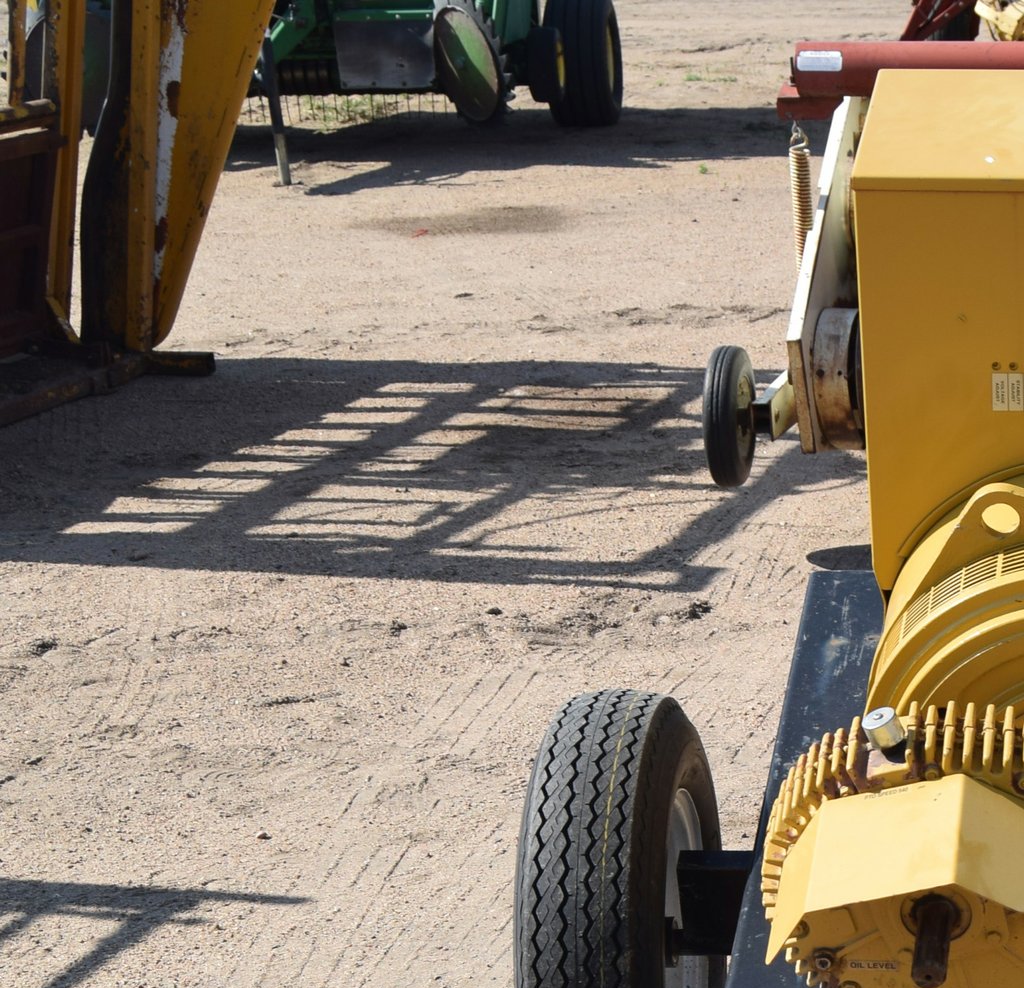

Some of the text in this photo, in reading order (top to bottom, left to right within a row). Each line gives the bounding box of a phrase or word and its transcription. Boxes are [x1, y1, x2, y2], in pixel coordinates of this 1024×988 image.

[877, 788, 897, 798] SPEED
[850, 961, 897, 970] OIL LEVEL
